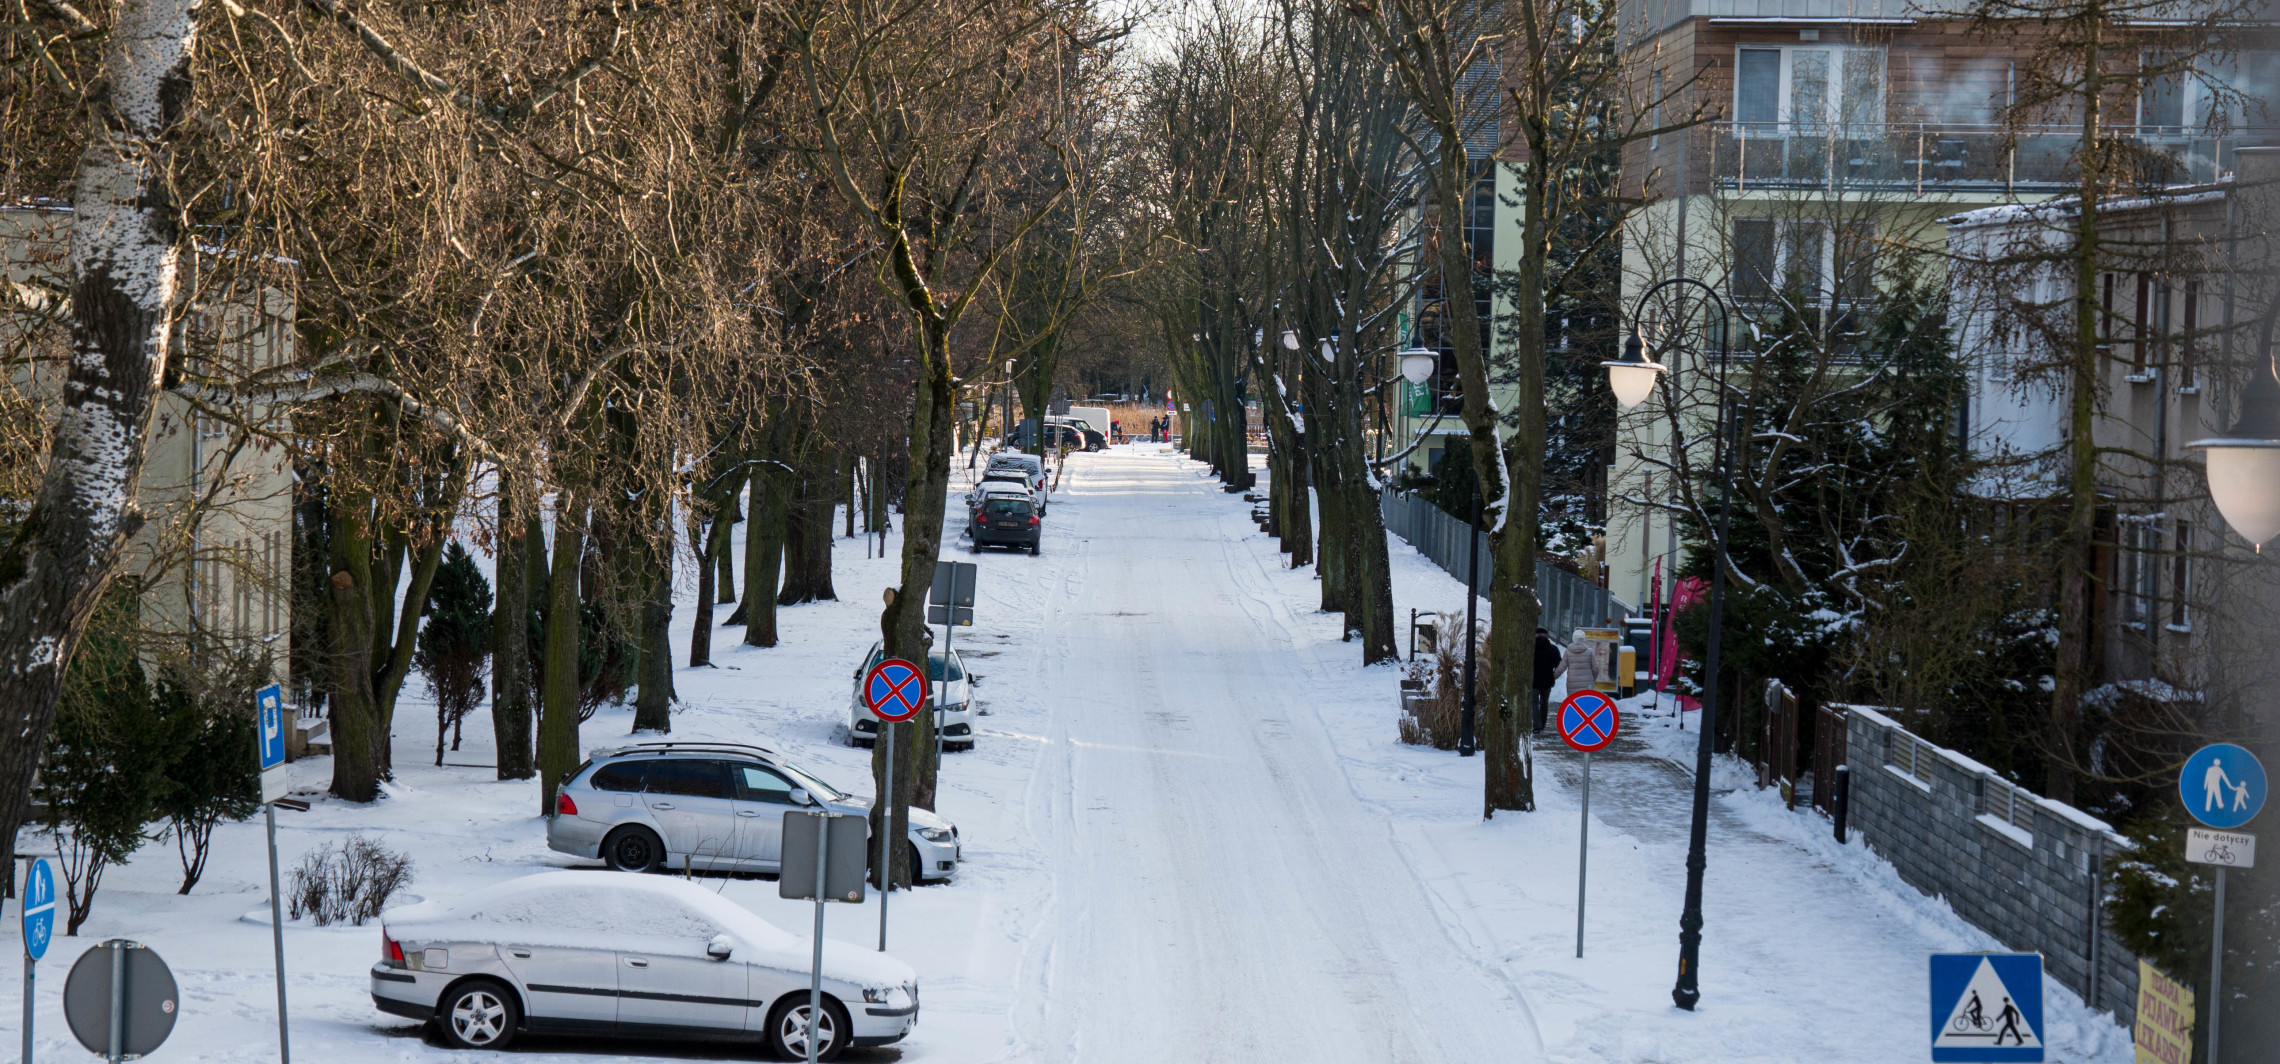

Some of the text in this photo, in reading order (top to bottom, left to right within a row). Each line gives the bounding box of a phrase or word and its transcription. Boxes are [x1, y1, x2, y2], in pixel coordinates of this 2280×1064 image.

[262, 695, 278, 758] P
[2193, 830, 2250, 846] Nie dotyczy
[2152, 972, 2179, 1005] TERAPIA
